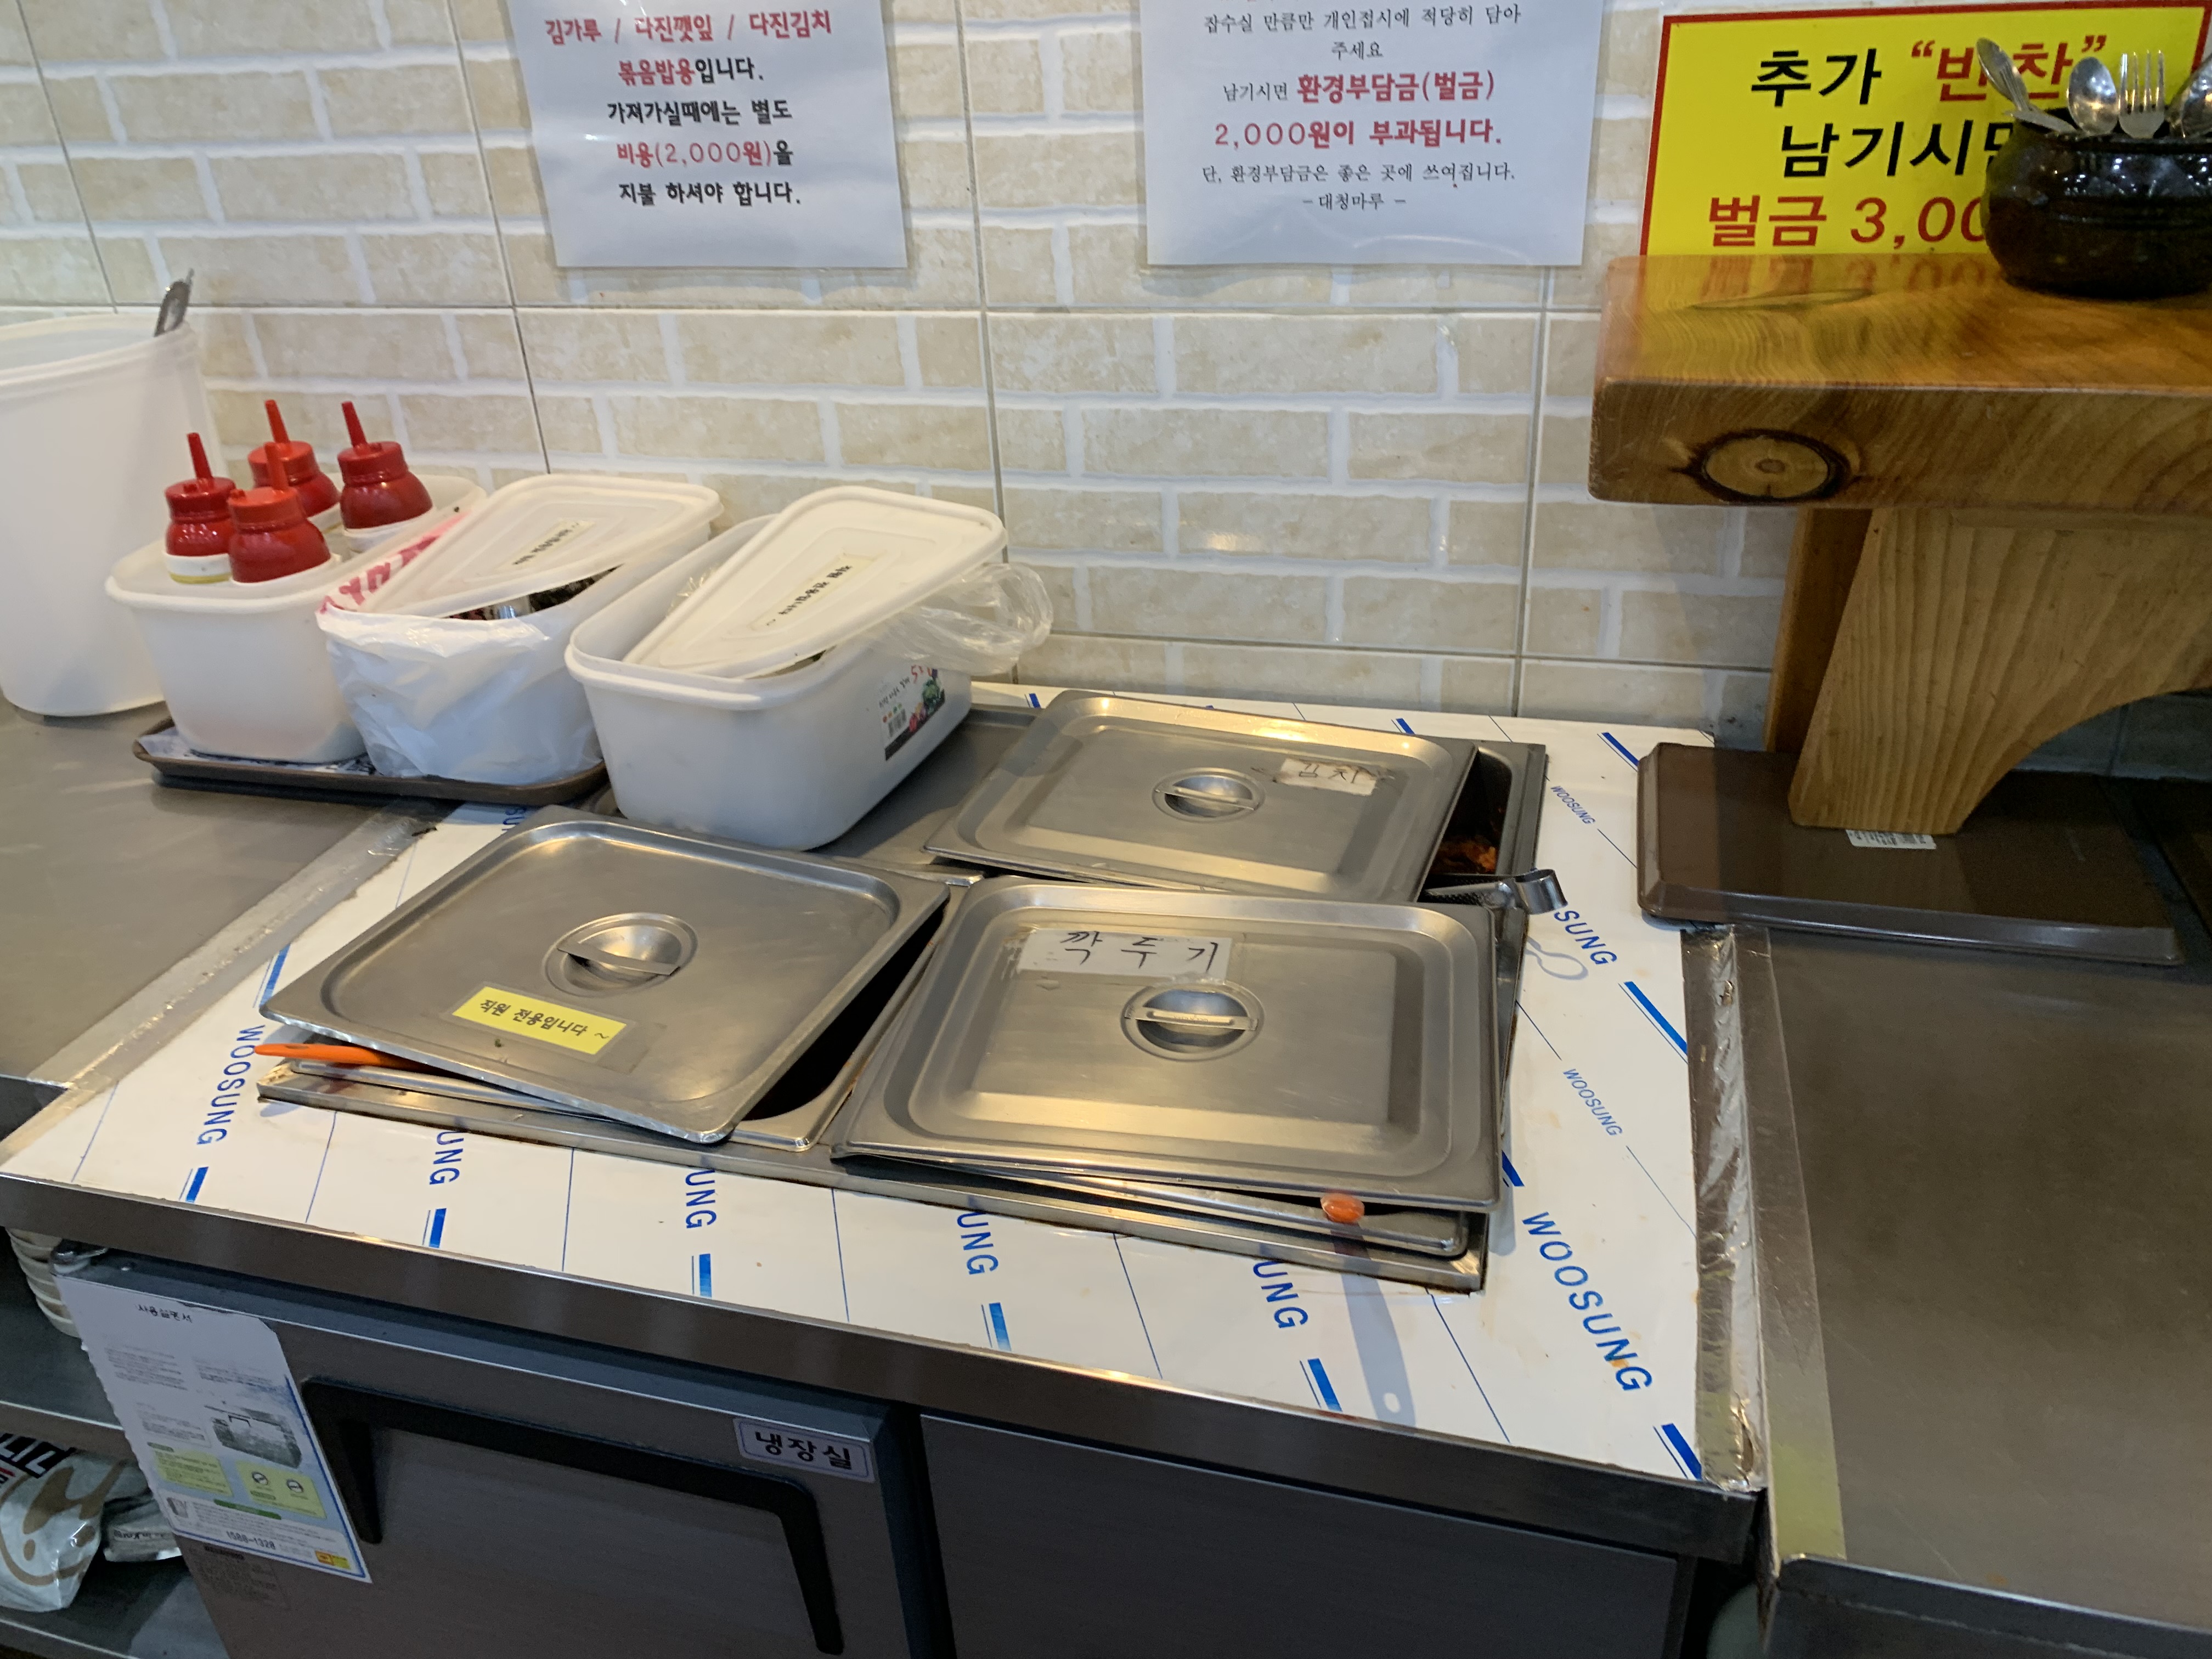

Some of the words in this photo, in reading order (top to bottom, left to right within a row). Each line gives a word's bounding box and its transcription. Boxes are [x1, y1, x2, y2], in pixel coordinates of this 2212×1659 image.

[545, 18, 602, 46] 김가루
[634, 14, 713, 43] 다진깻잎
[748, 9, 832, 39] 다진김치
[1205, 13, 1252, 34] 잡수실
[1263, 11, 1314, 32] 만큼만
[1324, 7, 1409, 30] 개인접시에
[1421, 5, 1473, 27] 적당히
[1331, 40, 1384, 60] 주세요
[618, 57, 764, 86] 볶음밥용입니다.
[1223, 82, 1288, 102] 남기시면
[1297, 70, 1494, 104] 환경부담금(벌금)
[1751, 48, 1882, 107] 추가
[607, 100, 741, 126] 가져가실때에는
[751, 99, 793, 125] 별도
[1215, 120, 1354, 150] 2,000원이
[1369, 118, 1502, 148] 부과됩니다.
[616, 139, 794, 168] 비용(2,000원)을
[1231, 164, 1329, 183] 환경부담금은
[1338, 164, 1371, 182] 좋은
[1380, 162, 1412, 182] 곳에
[1423, 162, 1515, 182] 쓰여집니다.
[618, 182, 656, 207] 지불
[665, 181, 724, 204] 하셔야
[732, 181, 802, 207] 합니다.
[1319, 193, 1384, 211] 대청마루
[1709, 195, 1827, 247] 벌금
[1550, 786, 1595, 825] WOOSUNG
[480, 1000, 511, 1016] 직원
[513, 1008, 588, 1036] 전용입니다
[196, 1025, 266, 1145] WOOSUNG
[1564, 1068, 1622, 1136] WOOSUNG
[1522, 1212, 1652, 1391] WOOSUNG
[755, 1431, 851, 1470] 냉장실
